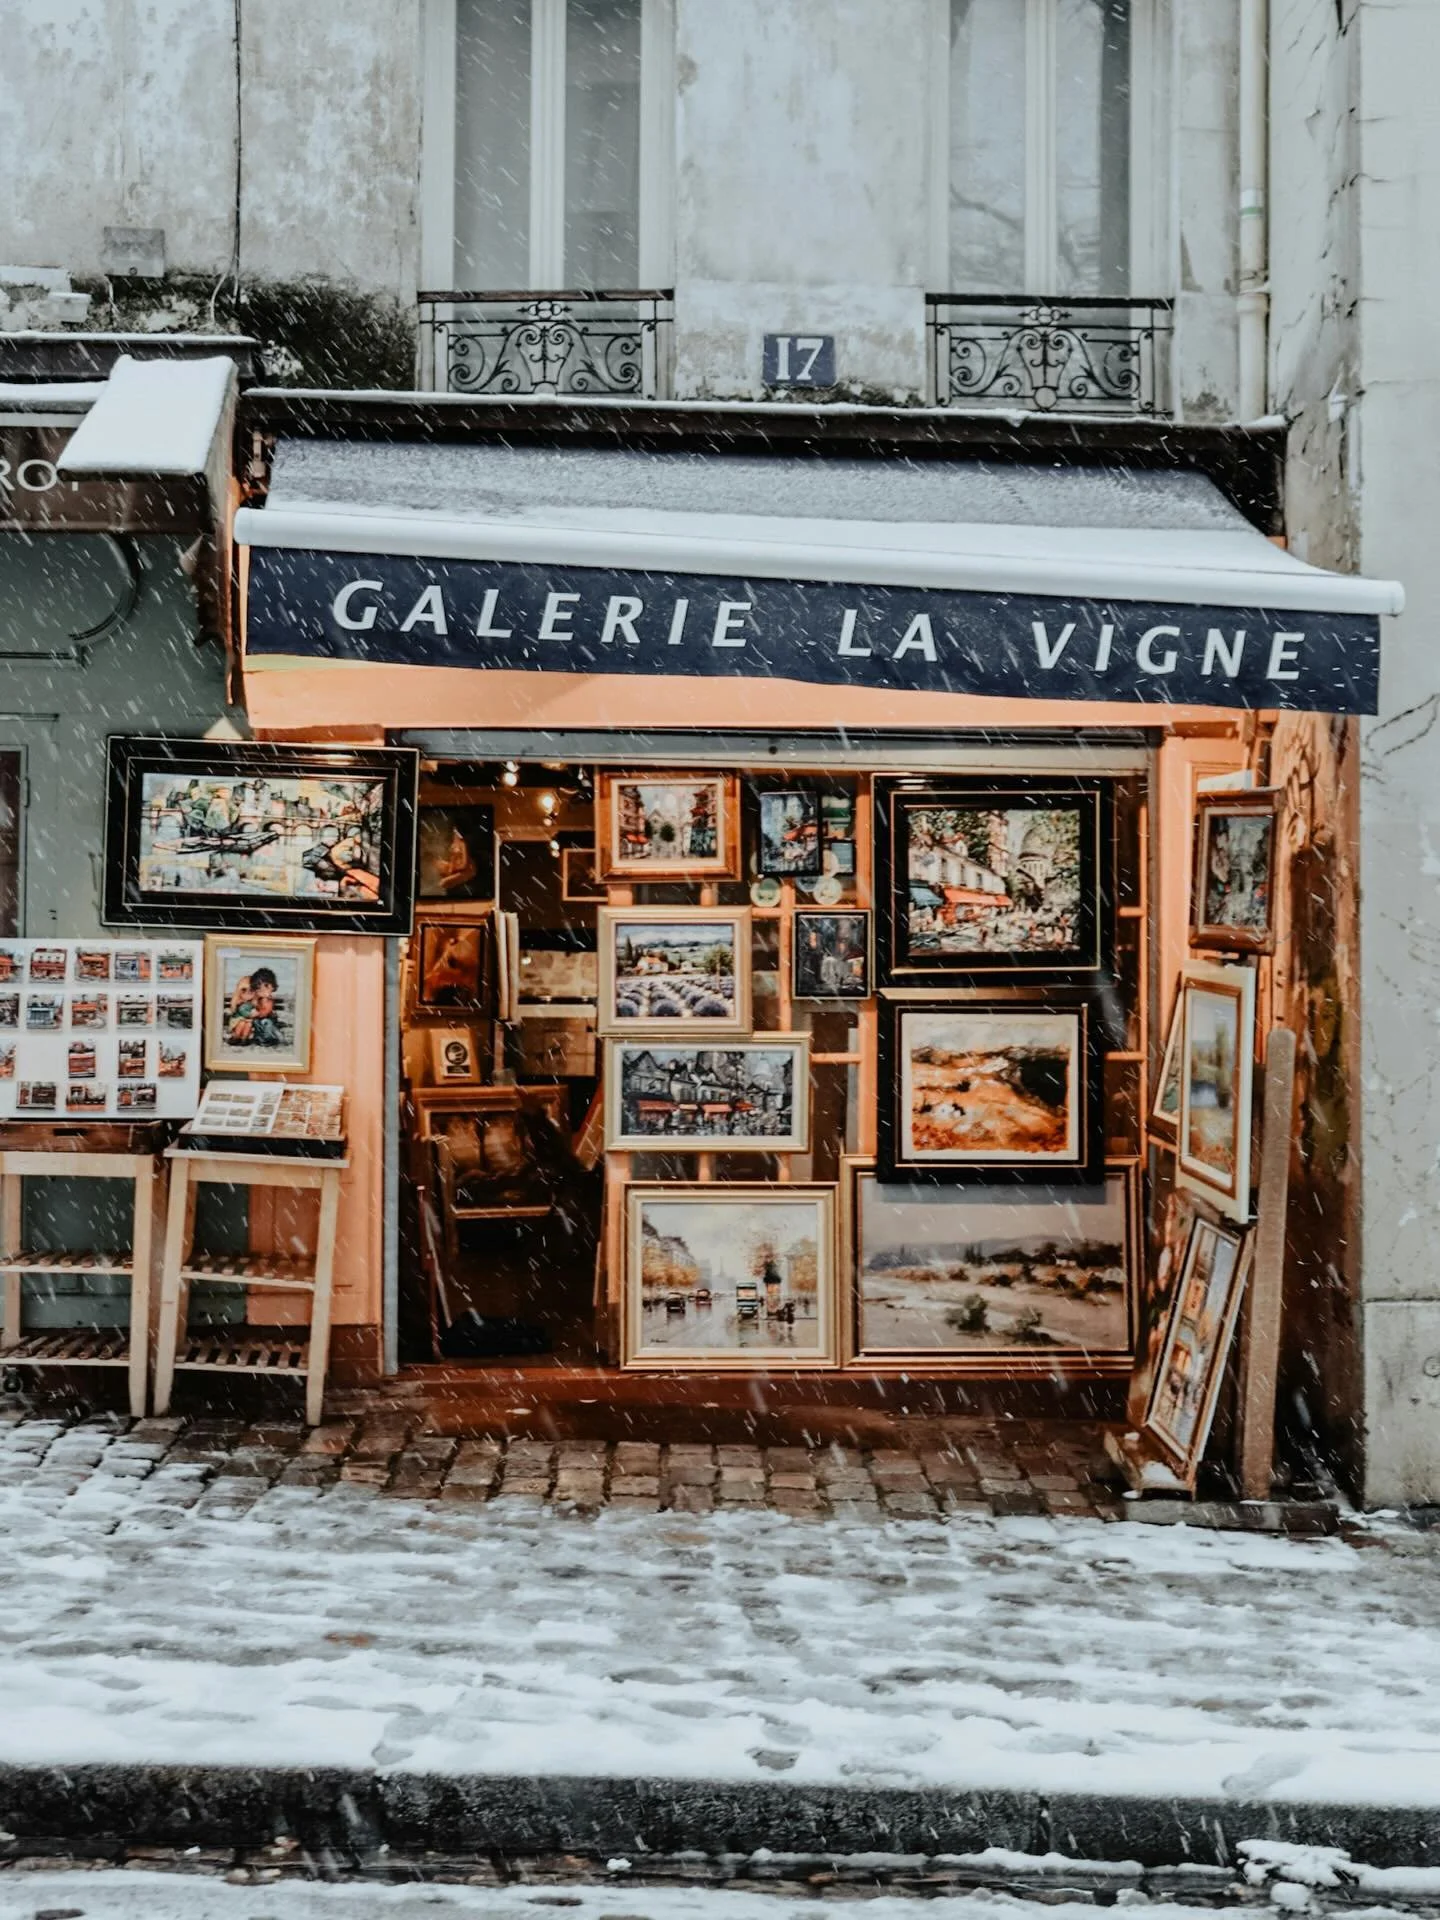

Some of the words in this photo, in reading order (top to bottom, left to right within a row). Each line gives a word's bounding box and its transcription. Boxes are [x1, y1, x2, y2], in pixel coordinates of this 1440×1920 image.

[775, 337, 824, 381] 17
[332, 579, 753, 648] GALERIE
[837, 608, 938, 662] LA
[1030, 620, 1306, 681] VIGNE
